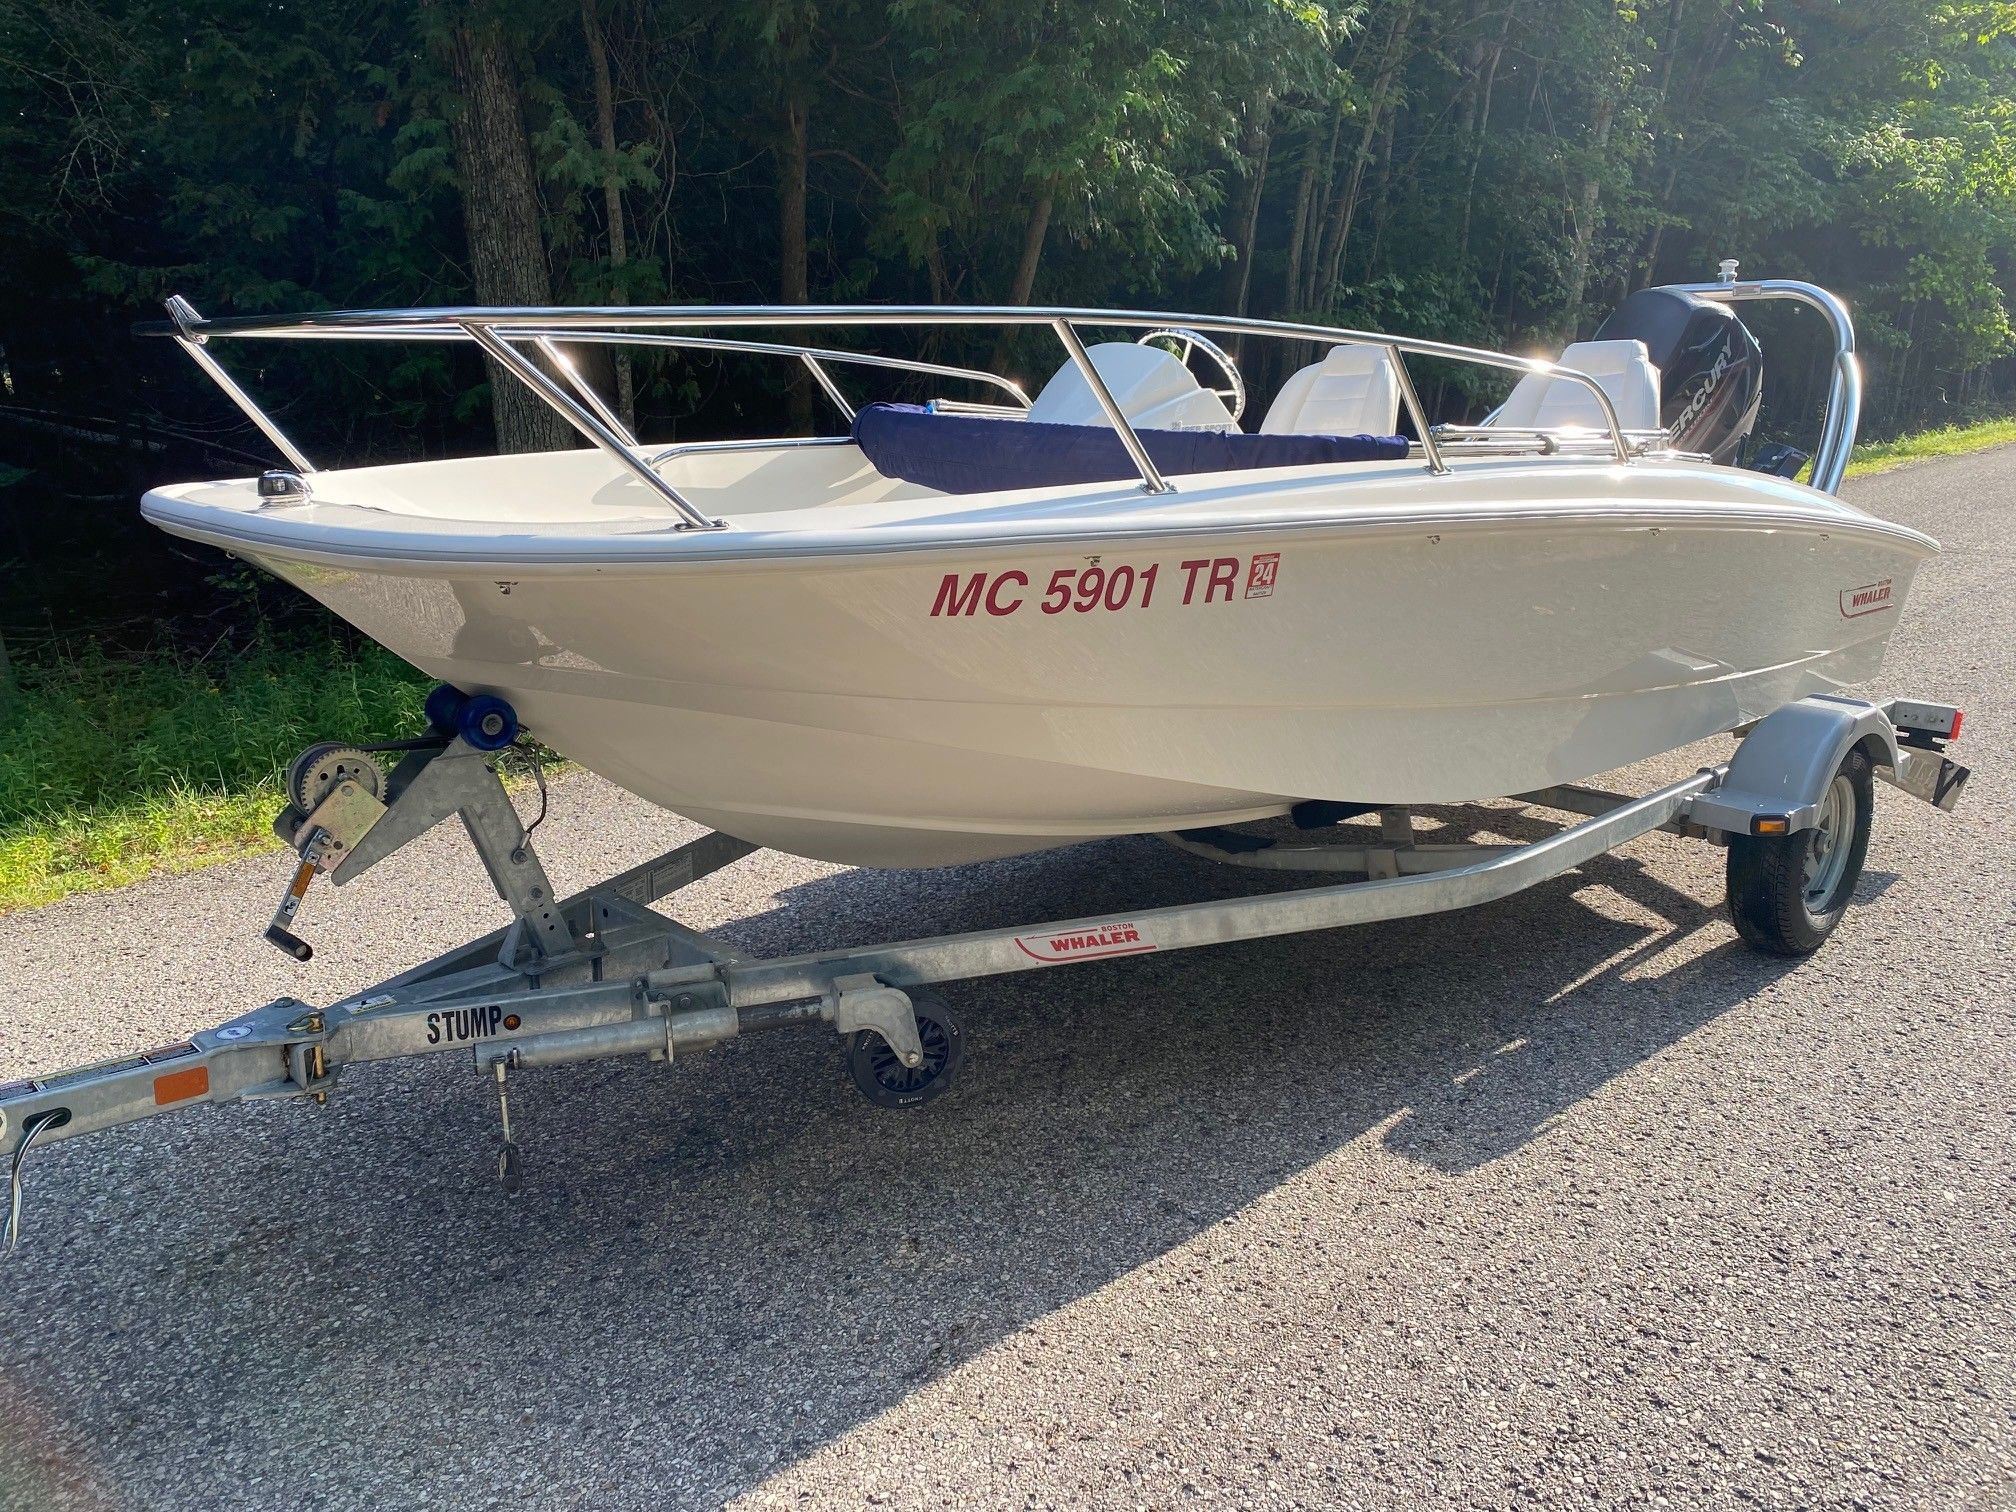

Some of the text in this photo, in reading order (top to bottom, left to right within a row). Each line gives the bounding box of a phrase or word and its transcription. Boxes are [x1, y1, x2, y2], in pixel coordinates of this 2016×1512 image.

[1668, 333, 1732, 446] ERCURY
[930, 557, 1239, 617] MC 5901 TR
[1252, 563, 1275, 587] 24
[1852, 587, 1891, 607] WHALER
[1101, 922, 1134, 933] BOSTON
[1050, 930, 1141, 952] WHALER
[427, 1005, 502, 1044] STUMP
